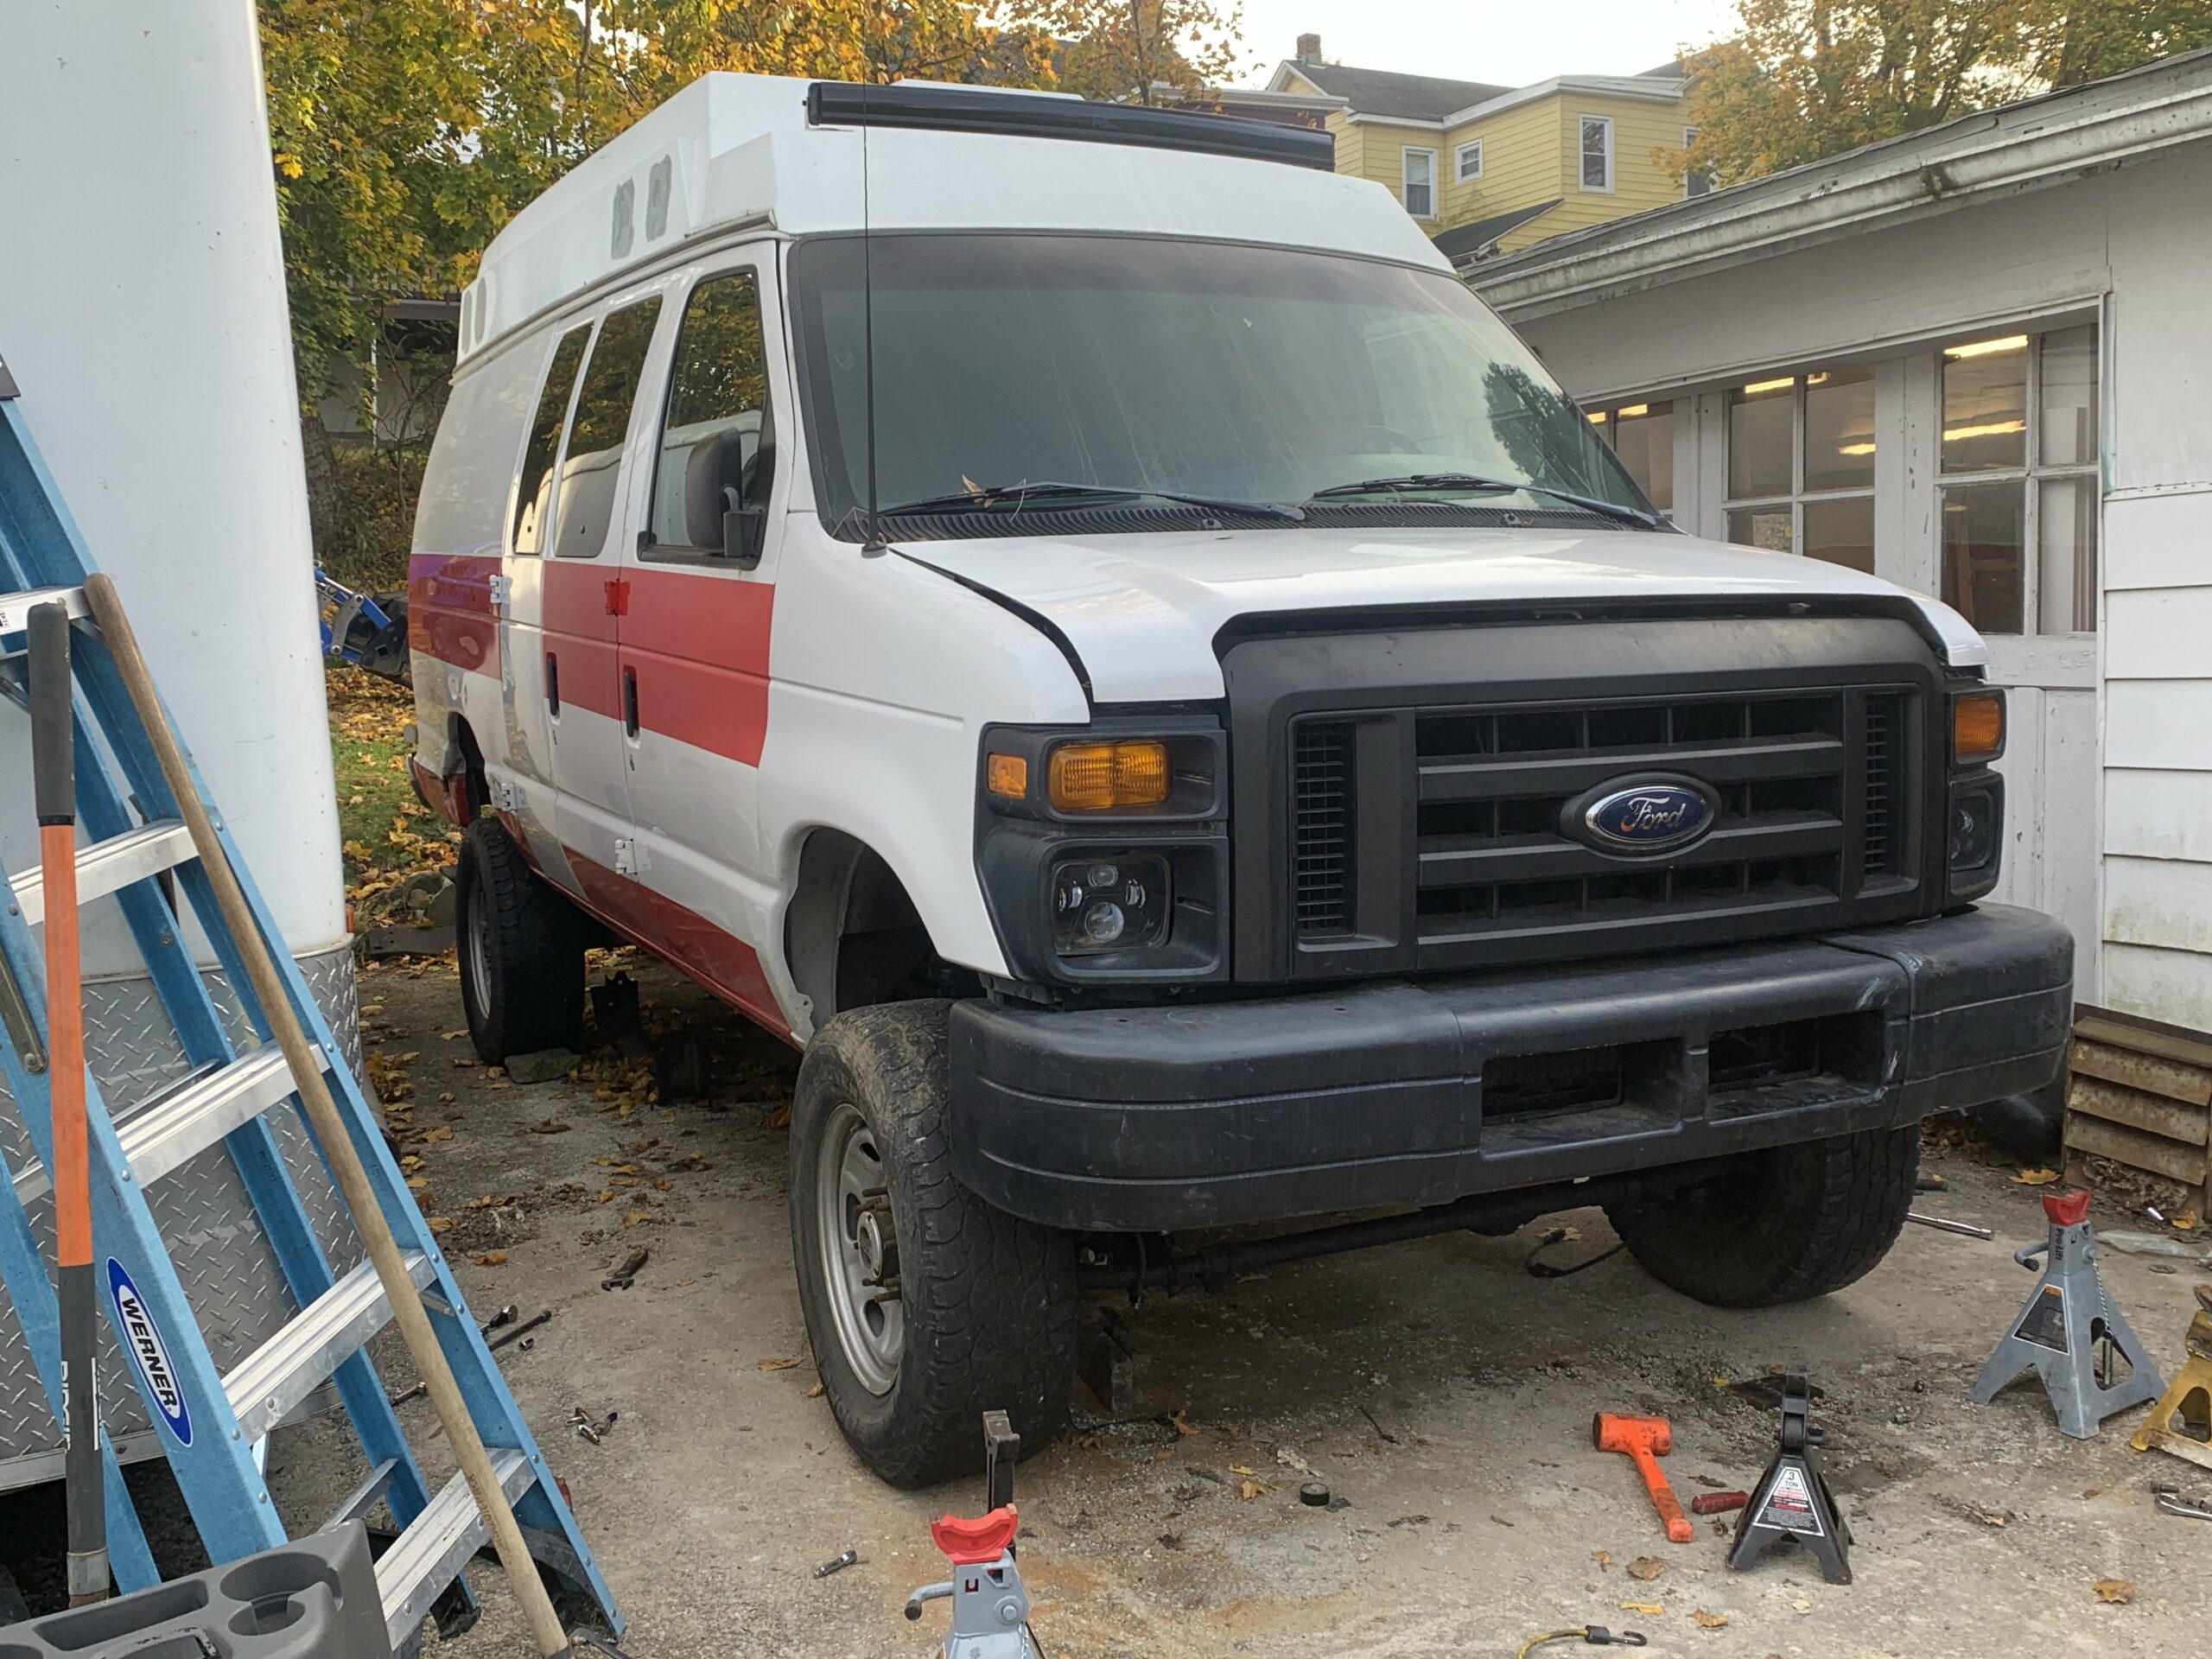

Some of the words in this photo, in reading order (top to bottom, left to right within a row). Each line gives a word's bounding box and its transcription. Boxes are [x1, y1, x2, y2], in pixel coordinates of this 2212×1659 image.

[1621, 796, 1687, 832] Ford
[122, 1297, 178, 1408] WERNER
[1789, 1471, 1796, 1481] 3
